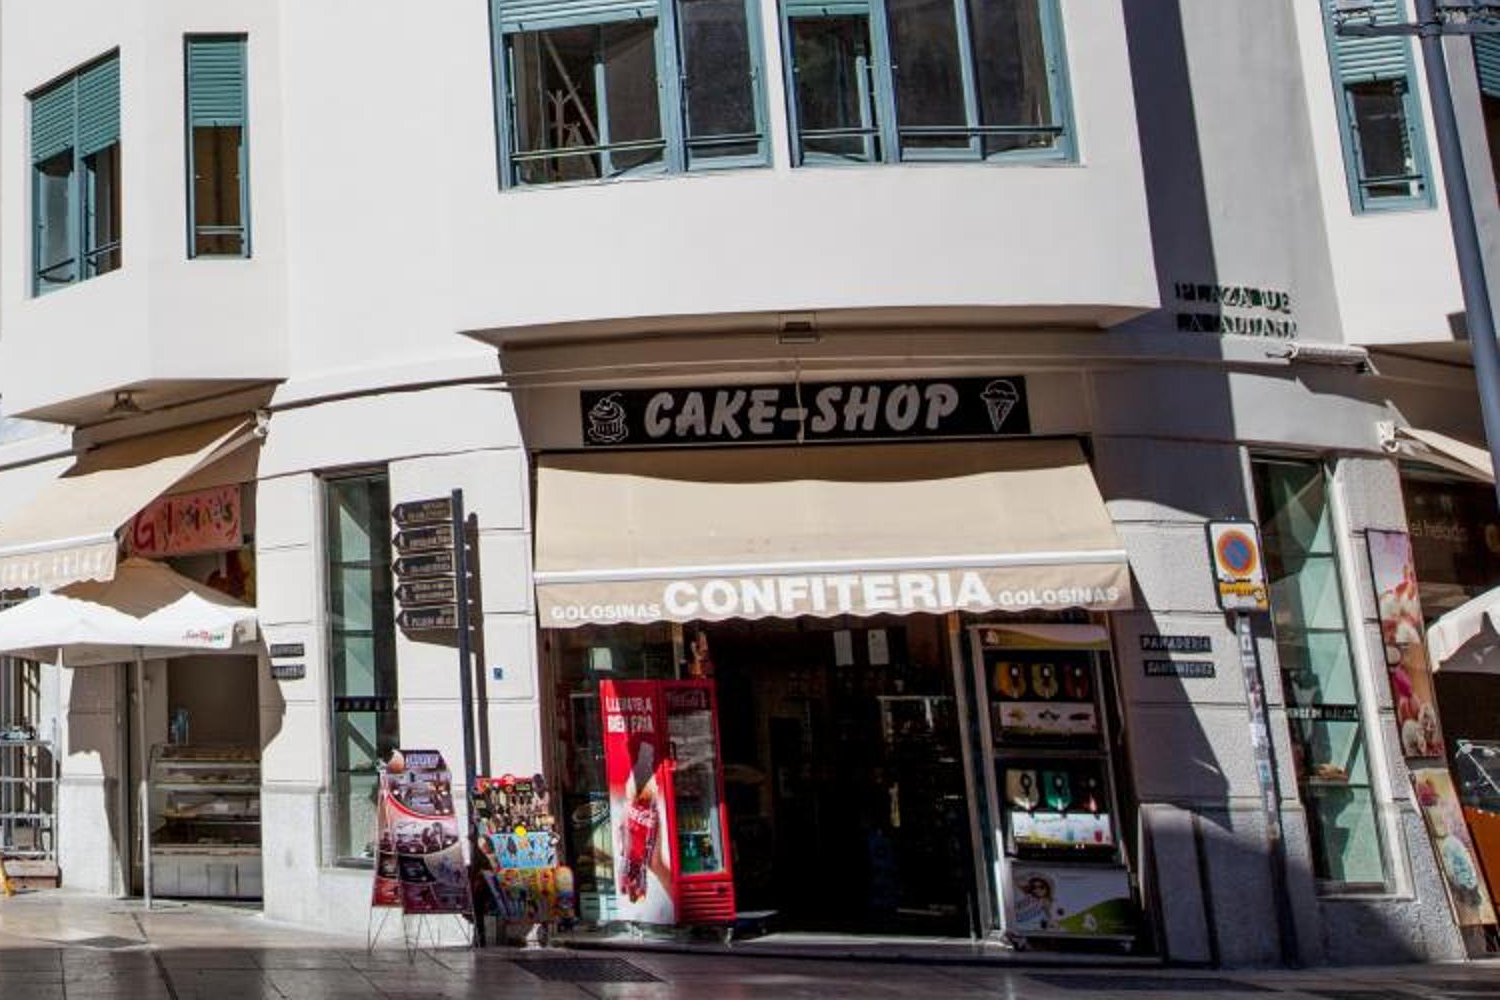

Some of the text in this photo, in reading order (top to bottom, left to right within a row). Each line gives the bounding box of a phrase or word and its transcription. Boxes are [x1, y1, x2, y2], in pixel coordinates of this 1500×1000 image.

[644, 383, 960, 440] CAKE-SHOP
[551, 570, 1120, 621] GOLOSINAS CONFITERIA GOLOSINAS
